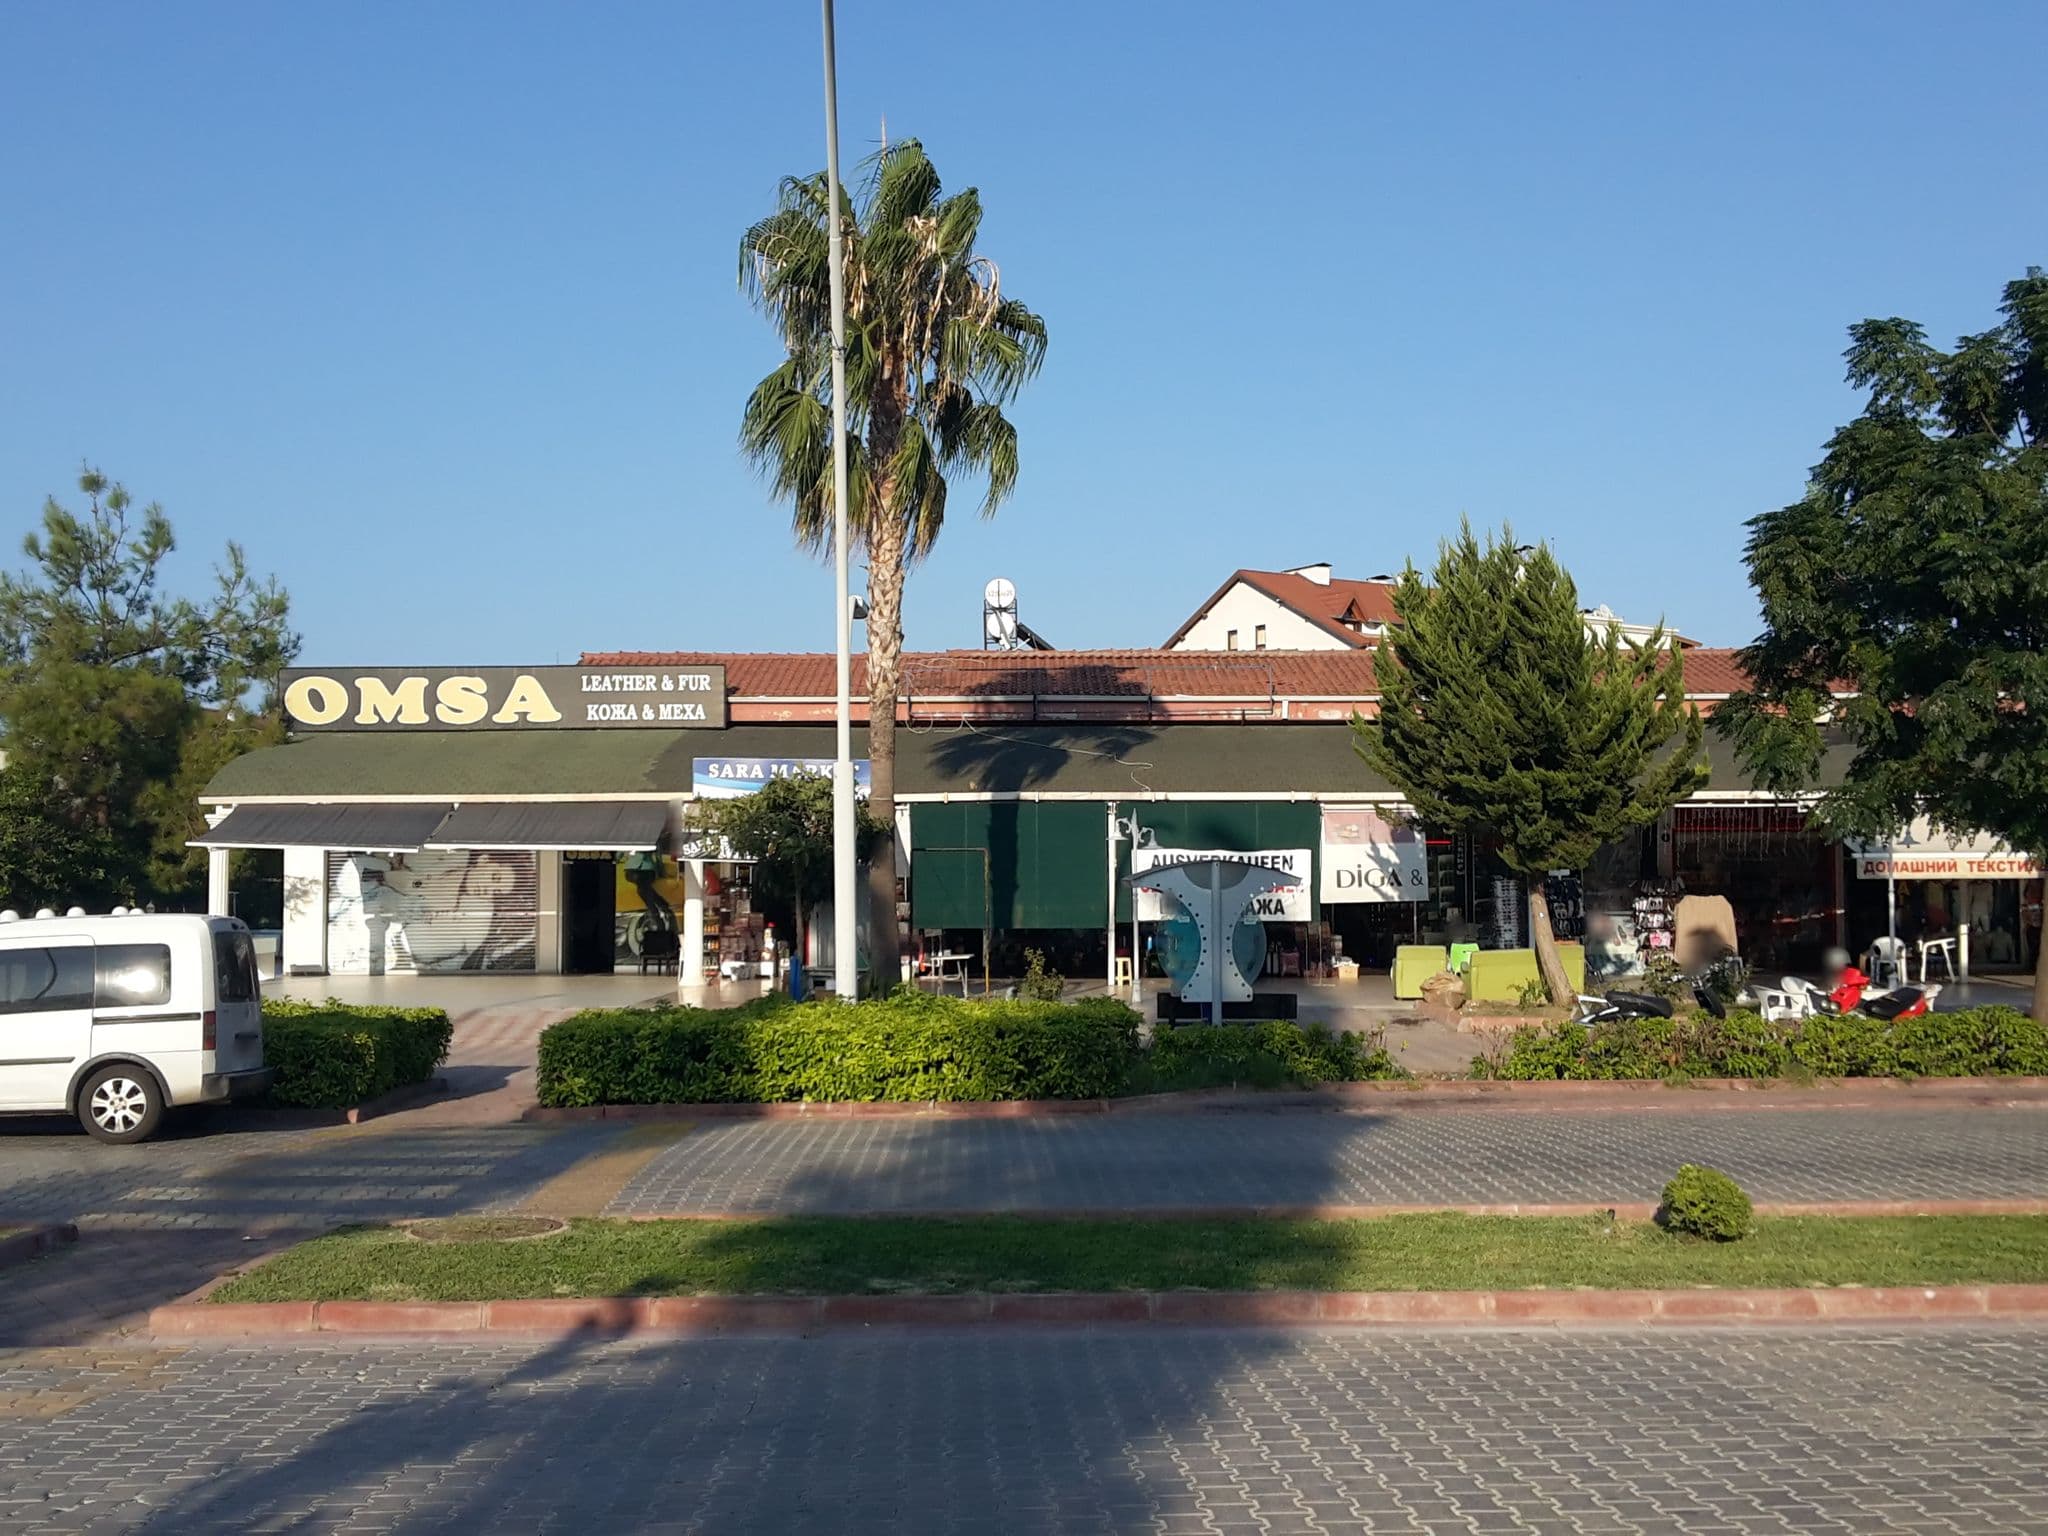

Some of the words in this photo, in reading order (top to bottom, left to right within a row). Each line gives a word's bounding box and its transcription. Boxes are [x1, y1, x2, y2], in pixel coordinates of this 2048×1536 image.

[581, 675, 657, 692] LEATHER
[661, 675, 674, 691] &
[678, 675, 711, 691] FUR
[284, 675, 562, 725] OMSA
[586, 704, 638, 721] КОЖА
[642, 704, 655, 720] &
[659, 704, 706, 720] МЕХА
[709, 763, 765, 779] SARA
[771, 763, 860, 780] MARK
[1863, 858, 1958, 875] ДОМАШНИЙ
[1411, 869, 1424, 886] &
